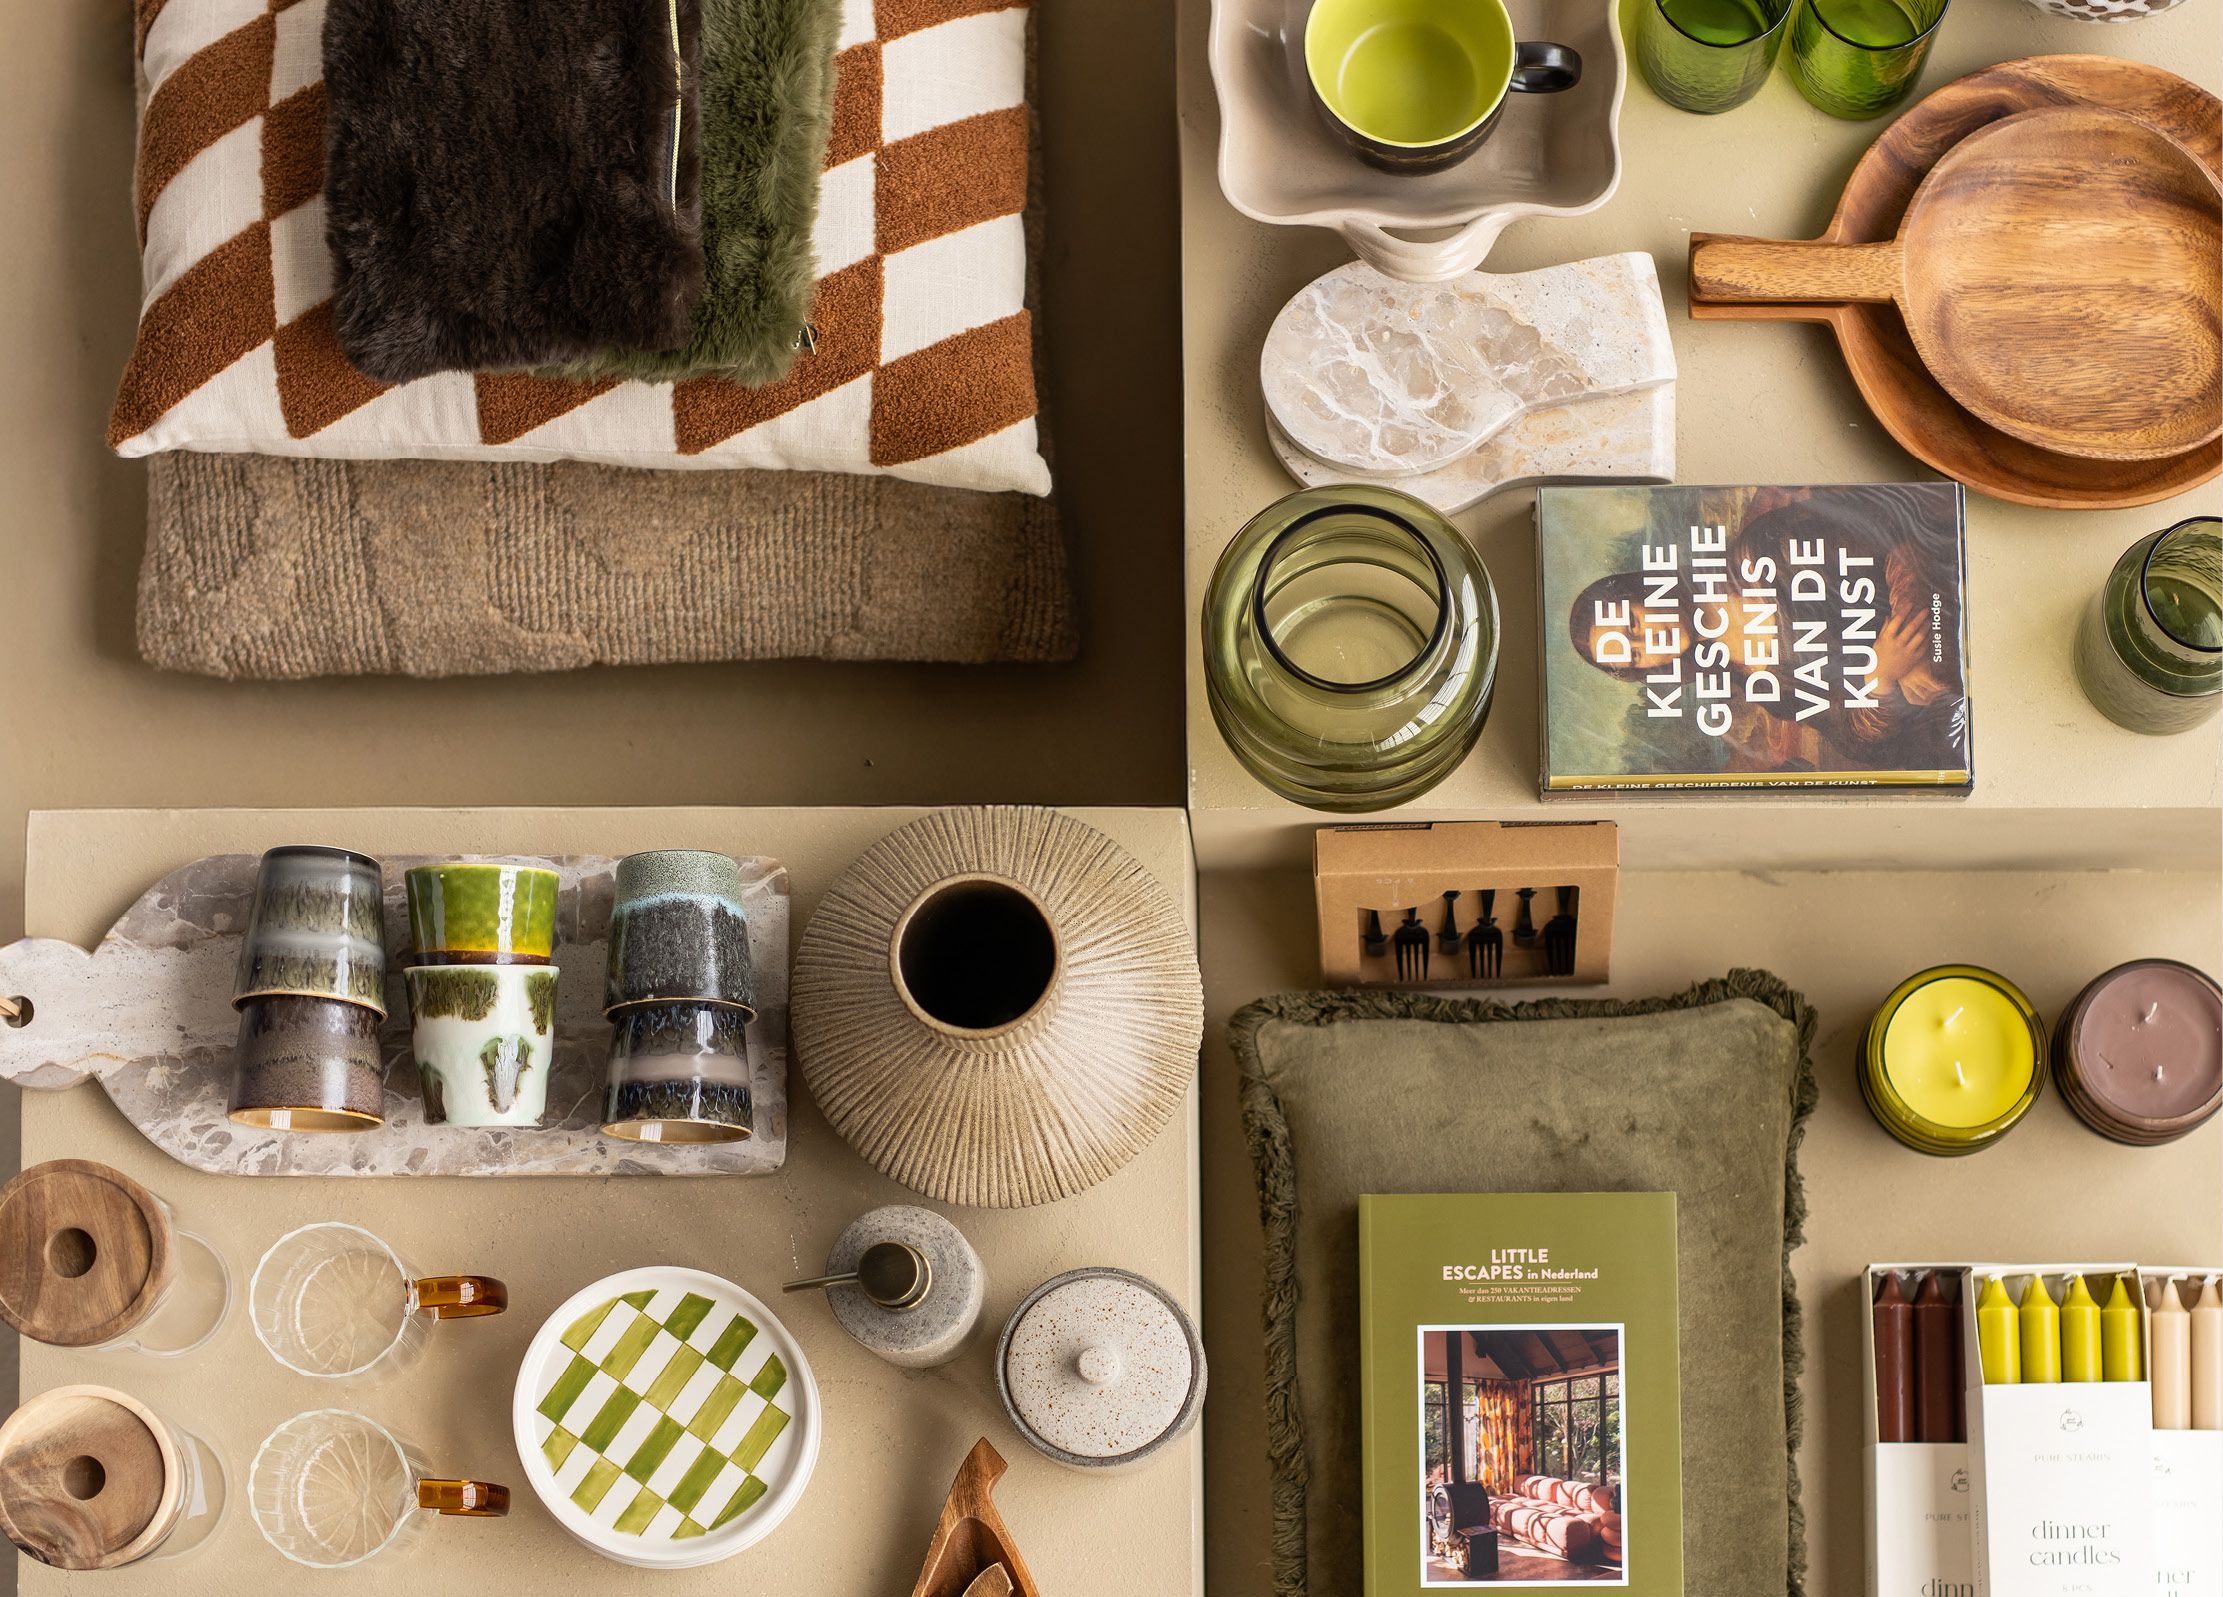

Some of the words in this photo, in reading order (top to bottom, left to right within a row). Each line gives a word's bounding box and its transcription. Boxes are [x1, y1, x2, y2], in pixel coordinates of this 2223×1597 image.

[1789, 538, 1825, 602] DE
[1931, 592, 1943, 631] Hodge
[1595, 599, 1632, 664] DE
[1642, 543, 1683, 718] KLEINE
[1691, 525, 1733, 737] GESCHIE
[1741, 555, 1781, 703] DENIS
[1839, 547, 1880, 709] KUNST
[1932, 632, 1943, 663] Susie
[1792, 621, 1831, 722] VAN
[1491, 1248, 1549, 1264] LITTLE
[1442, 1265, 1523, 1281] ESCAPES
[1527, 1269, 1538, 1280] in
[1541, 1268, 1599, 1280] Nederland
[1468, 1295, 1475, 1303] &
[1476, 1295, 1532, 1303] RESTAURANTS
[1541, 1296, 1558, 1304] eigen
[1478, 1286, 1489, 1294] dan
[1490, 1286, 1502, 1294] 250
[1503, 1286, 1582, 1294] VAKANTIEADRESSEN
[2034, 1454, 2061, 1463] PURE
[1925, 1512, 1951, 1521] PURE
[2032, 1520, 2111, 1539] dinner
[2029, 1545, 2121, 1566] candles
[1921, 1578, 1974, 1597] dinn
